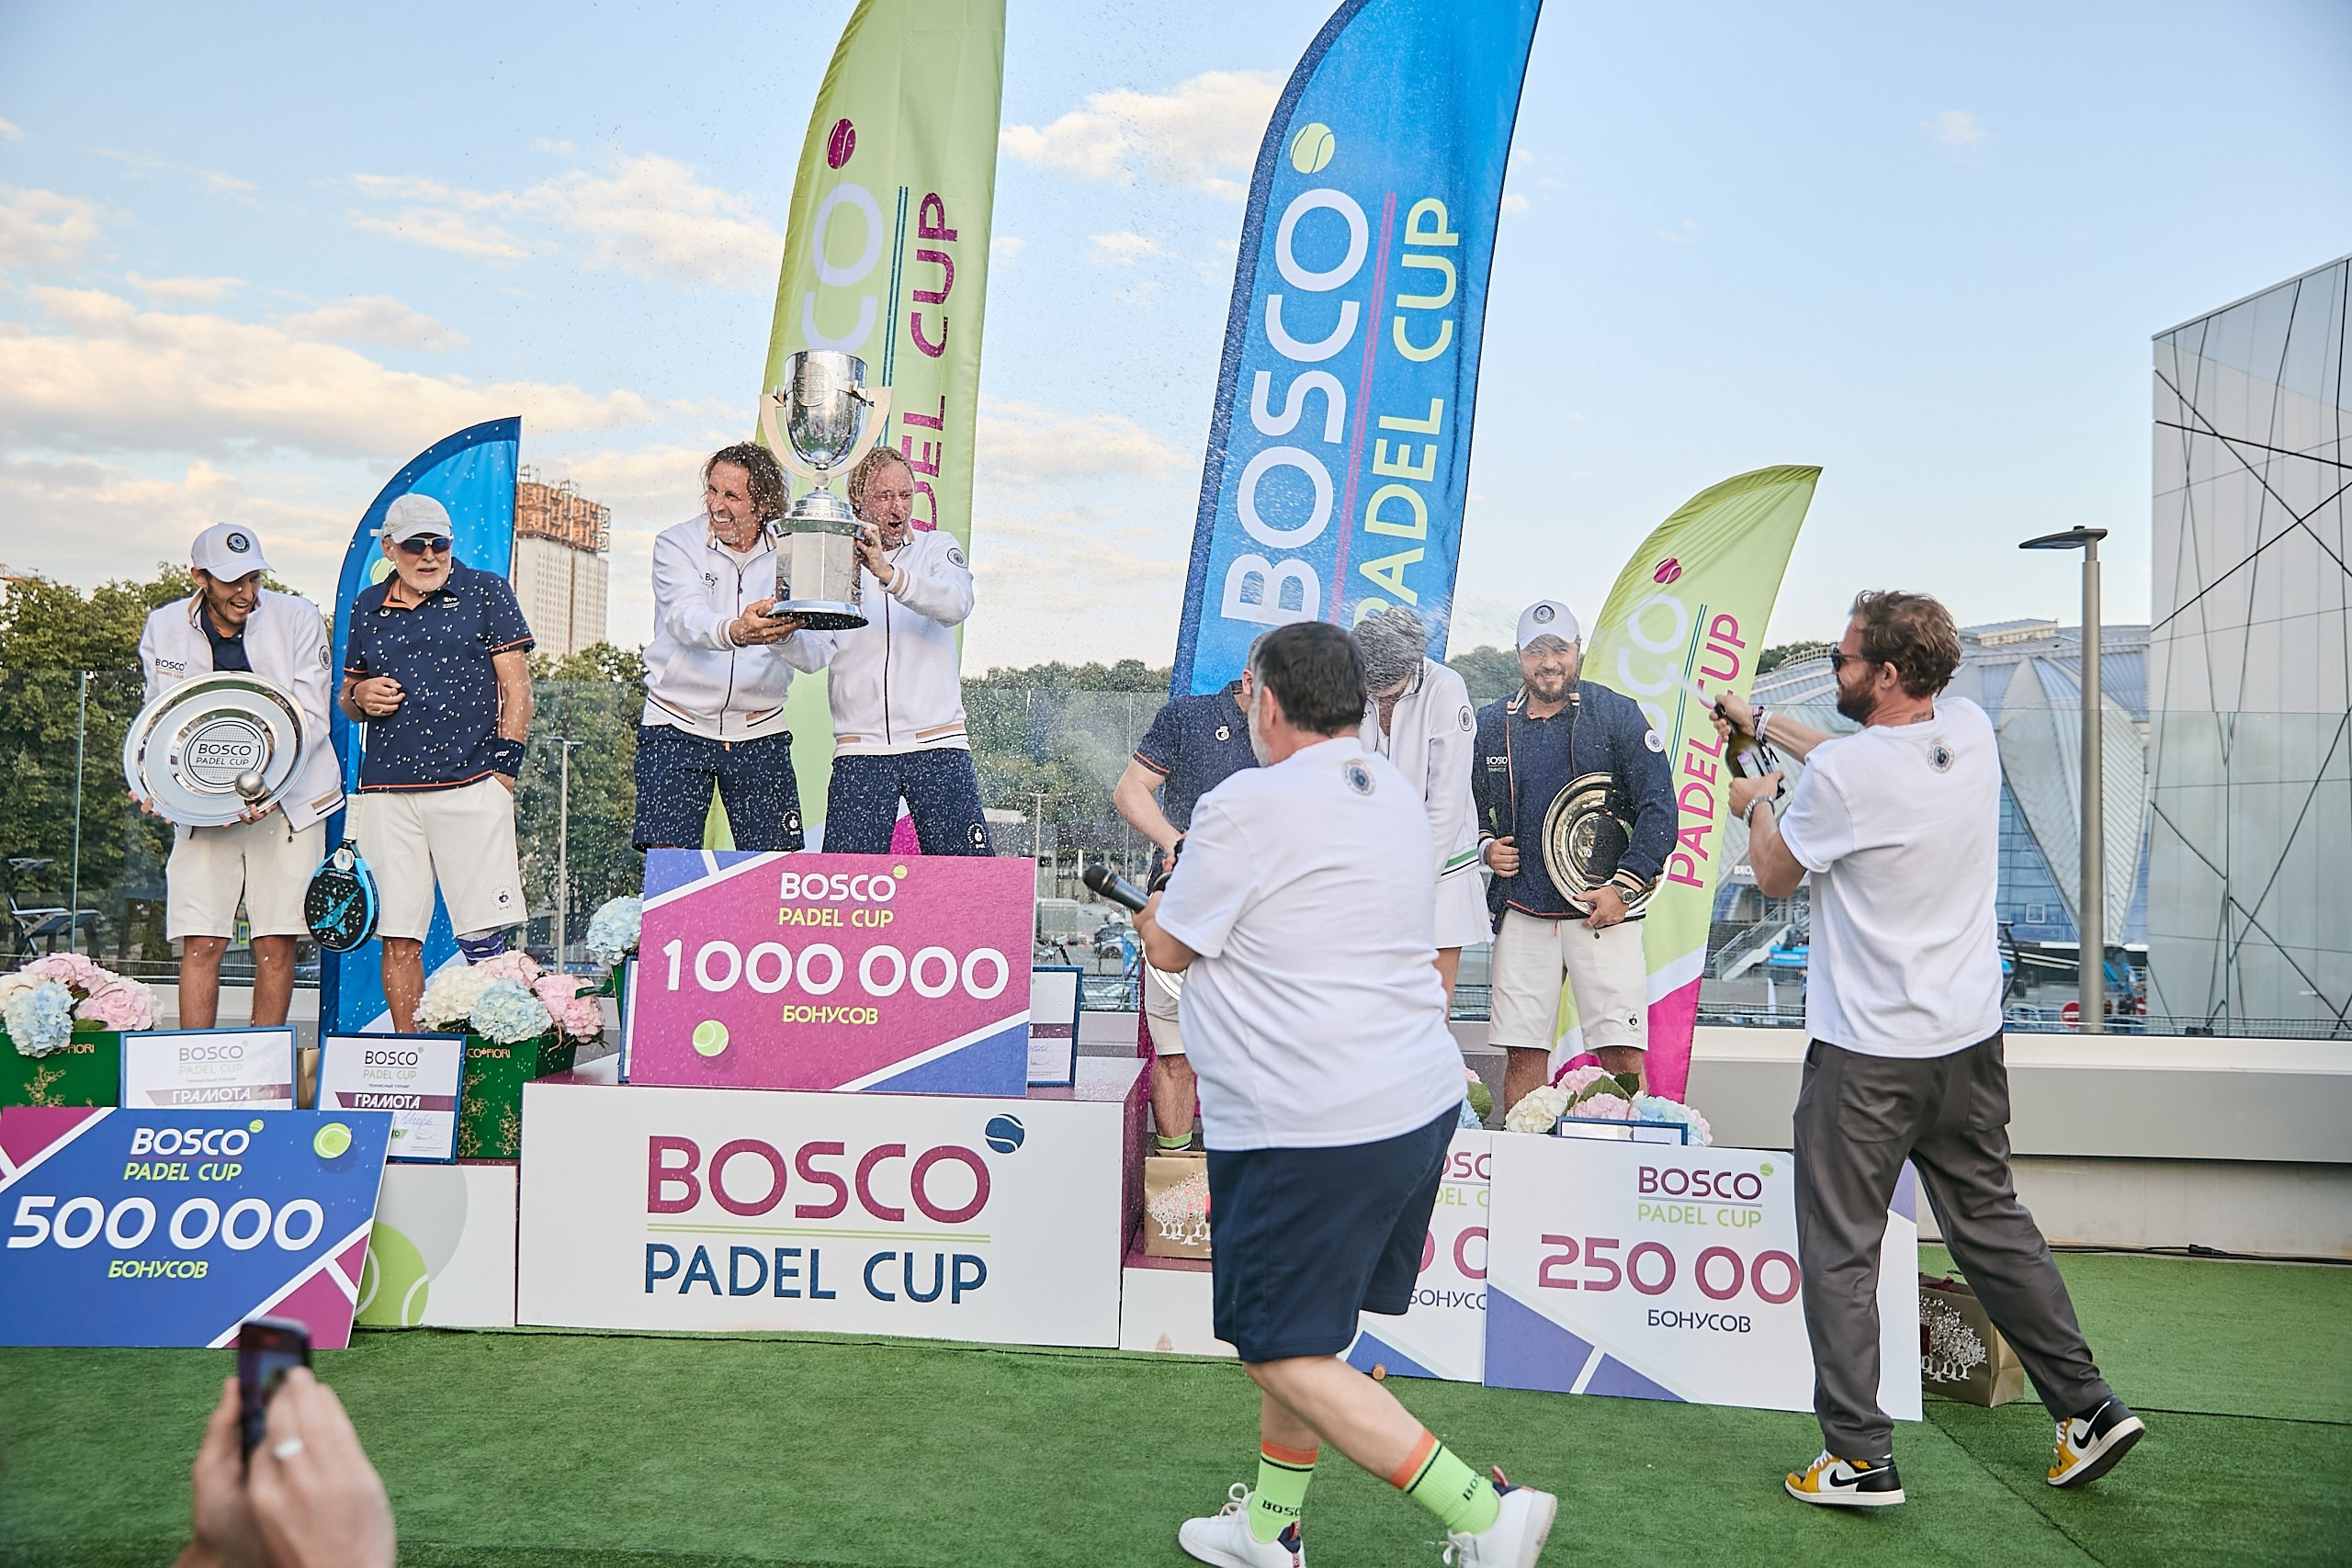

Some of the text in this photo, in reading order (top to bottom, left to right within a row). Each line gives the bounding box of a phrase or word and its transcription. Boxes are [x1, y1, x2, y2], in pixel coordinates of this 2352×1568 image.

[1393, 197, 1459, 362] CUP
[901, 191, 958, 533] DEL CUP
[1220, 188, 1369, 626] BOSCO
[155, 659, 185, 671] BOSCO
[198, 743, 252, 756] BOSCO
[196, 757, 249, 766] PADEL CUP
[1667, 735, 1724, 888] PADEL
[1734, 865, 1755, 876] ВХО
[780, 872, 898, 902] BOSCO
[779, 908, 894, 929] PADEL CUP
[858, 945, 1009, 1000] 000
[783, 1005, 878, 1026] БОНУСОВ
[179, 1045, 243, 1061] BOSCO
[365, 1050, 418, 1066] BOSCO
[178, 1063, 243, 1075] PADEL CUP
[363, 1069, 417, 1080] PADEL CUP
[173, 1088, 251, 1104] ГРАМОТА
[355, 1093, 422, 1110] ГРАМОТА
[130, 1127, 250, 1156] BOSCO
[123, 1163, 243, 1181] PADEL CUP
[648, 1134, 991, 1224] BOSCO
[1638, 1166, 1762, 1201] BOSCO
[6, 1195, 324, 1251] 500 000
[1637, 1202, 1762, 1229] PADEL CUP
[108, 1259, 209, 1280] БОНУСОВ
[645, 1243, 988, 1304] PADEL CUP
[1538, 1234, 1677, 1295] 250
[1694, 1246, 1800, 1304] 00
[1647, 1309, 1751, 1334] БОНУСОВ
[1261, 1498, 1300, 1517] BOSC
